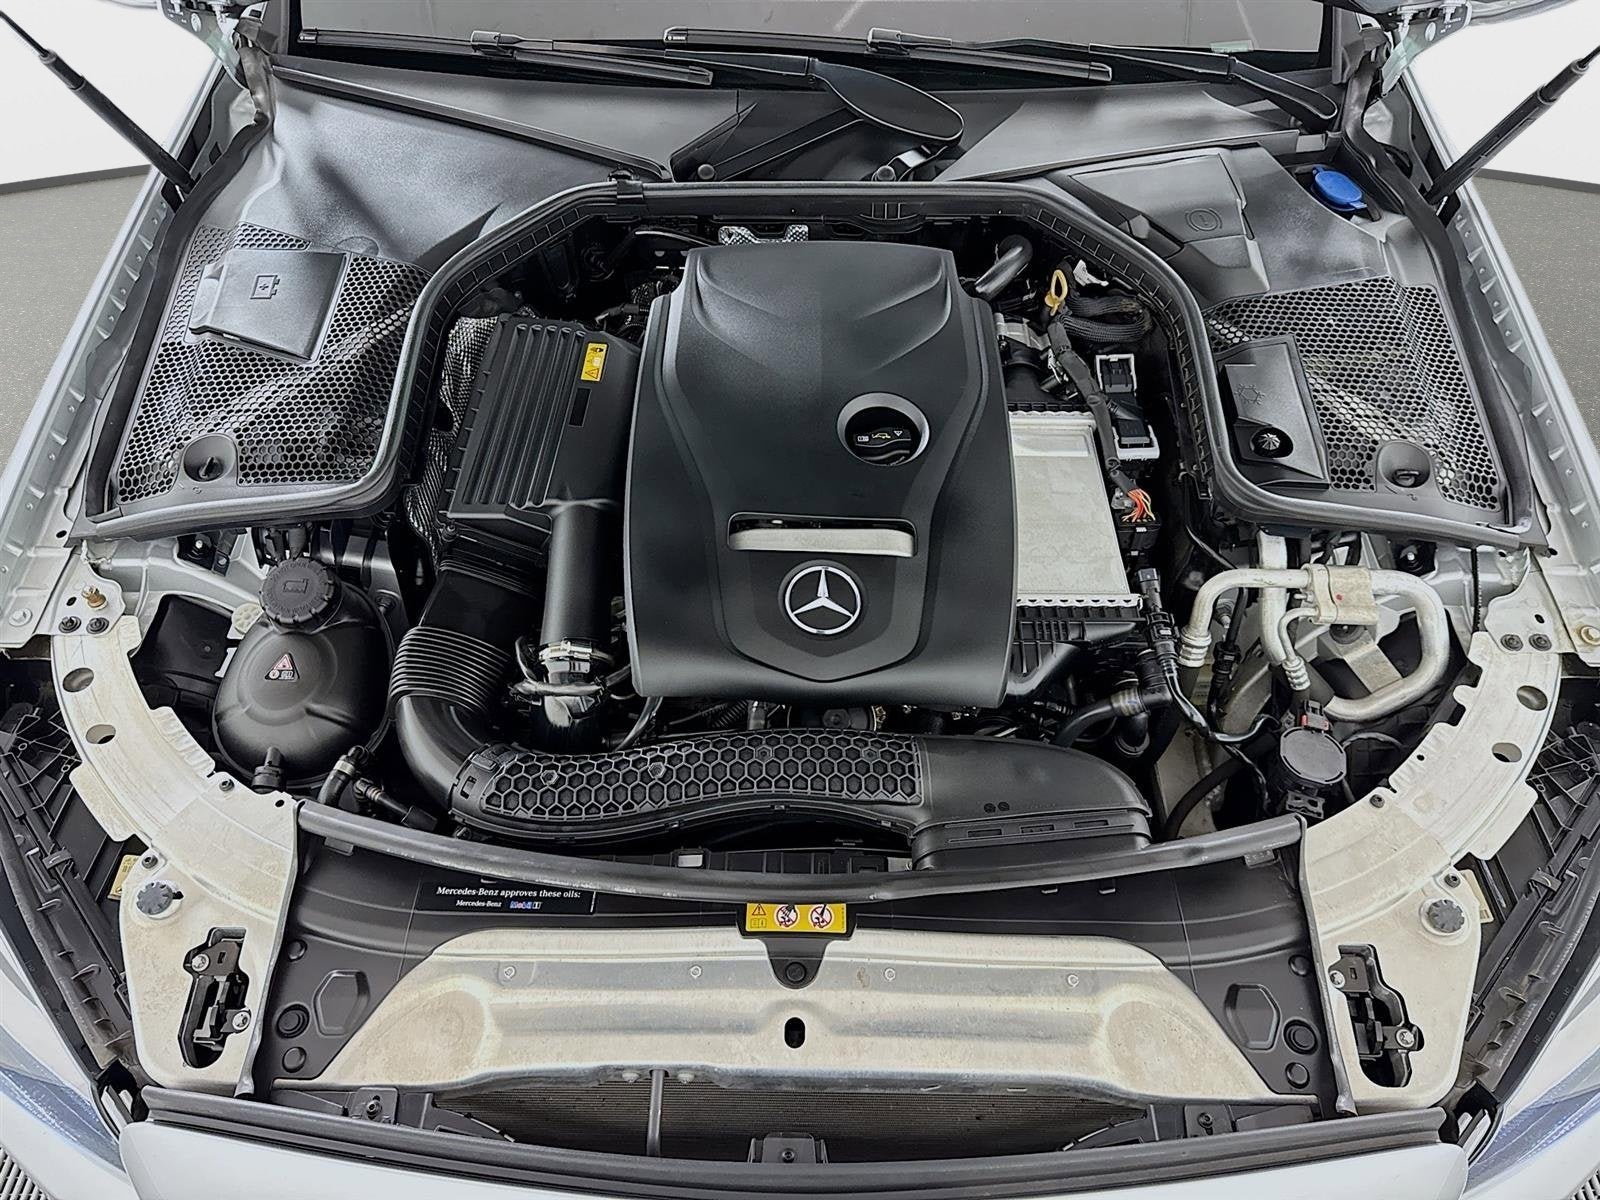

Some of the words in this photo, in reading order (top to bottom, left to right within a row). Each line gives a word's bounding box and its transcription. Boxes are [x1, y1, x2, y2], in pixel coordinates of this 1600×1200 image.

[436, 886, 499, 896] Mercedes-Benz
[500, 889, 537, 898] approves
[539, 889, 562, 898] these
[563, 890, 581, 898] oils:
[456, 899, 502, 907] Mercedes-Benz
